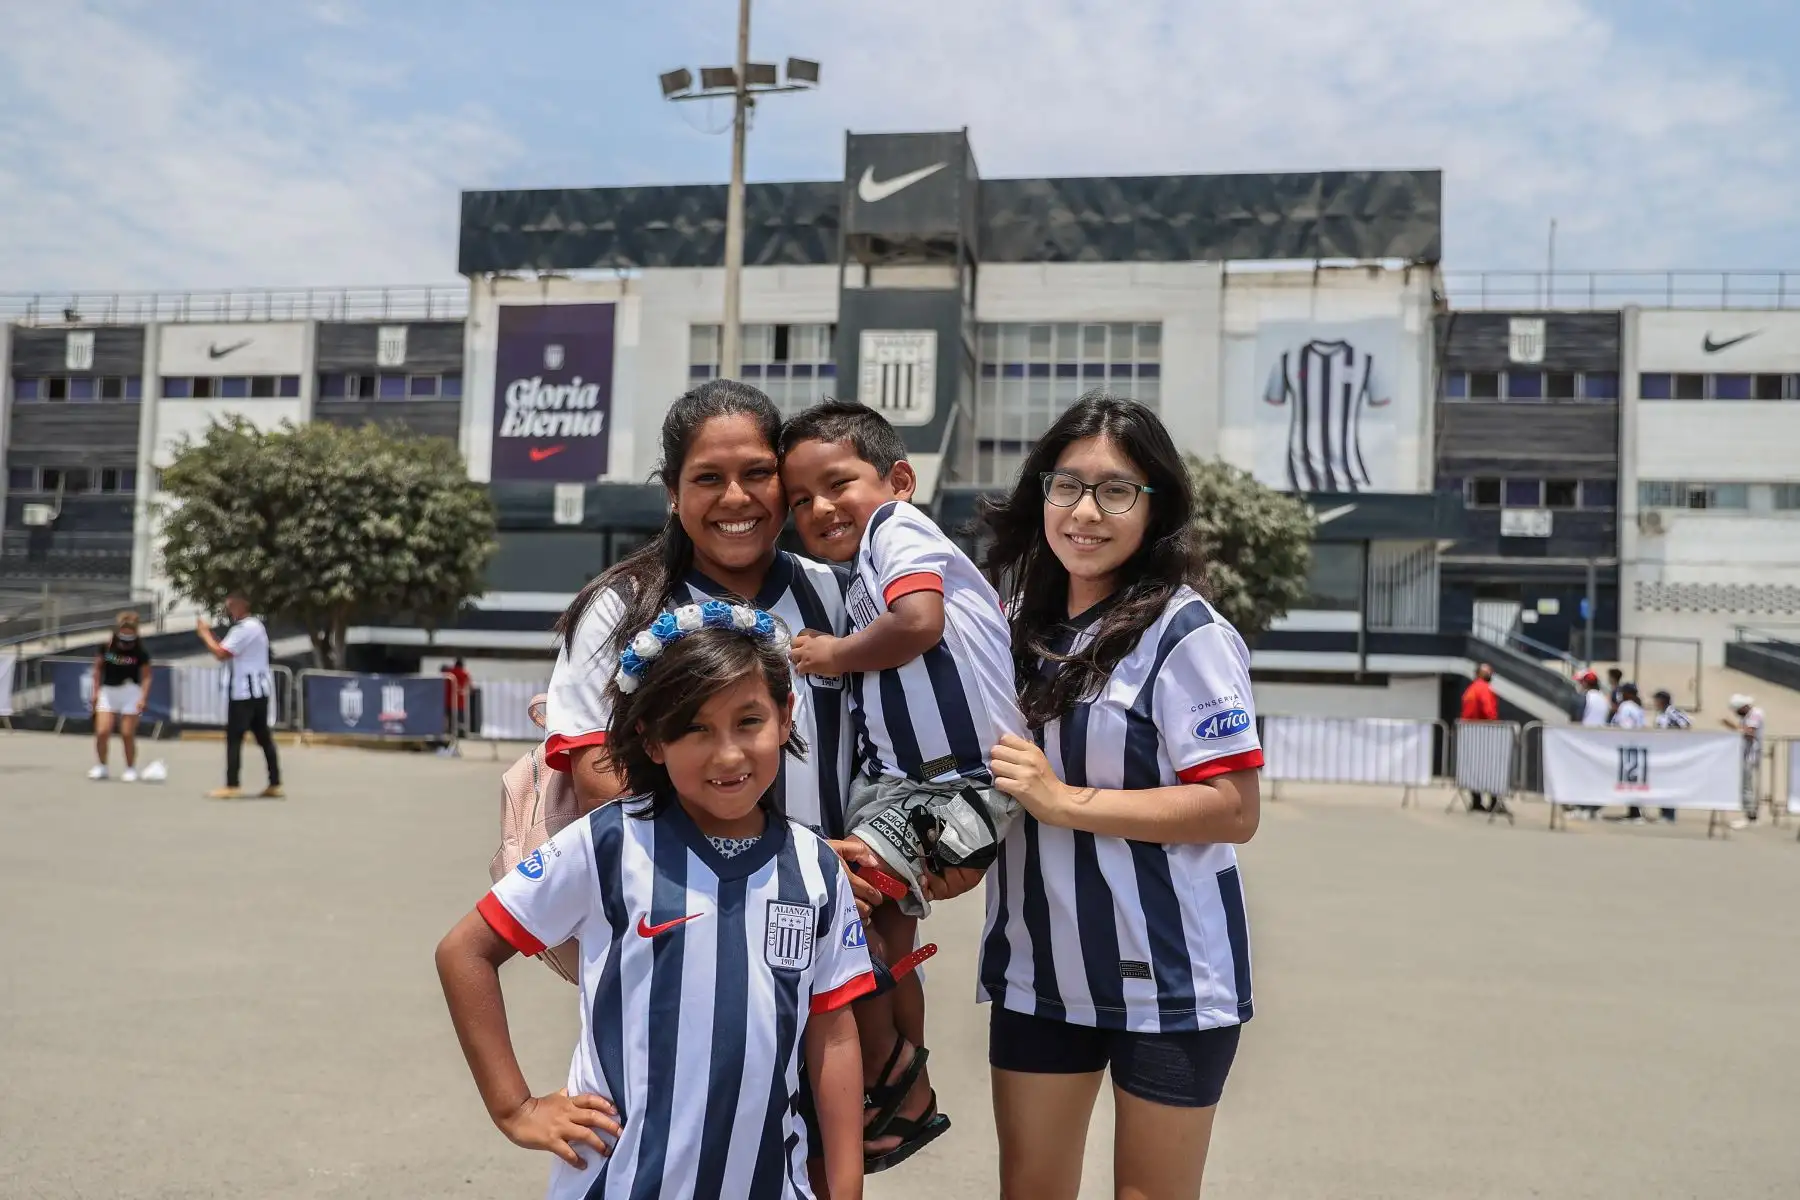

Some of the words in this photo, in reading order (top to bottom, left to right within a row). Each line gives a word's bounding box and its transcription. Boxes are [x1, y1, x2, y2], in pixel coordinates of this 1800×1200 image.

[505, 375, 600, 410] Gloria
[499, 408, 604, 437] Eterna
[1616, 746, 1648, 784] 121
[872, 820, 903, 847] adidas
[774, 905, 810, 917] ALIANZA
[768, 922, 777, 946] CLUB
[803, 926, 812, 951] LIMA
[781, 958, 795, 967] 1901
